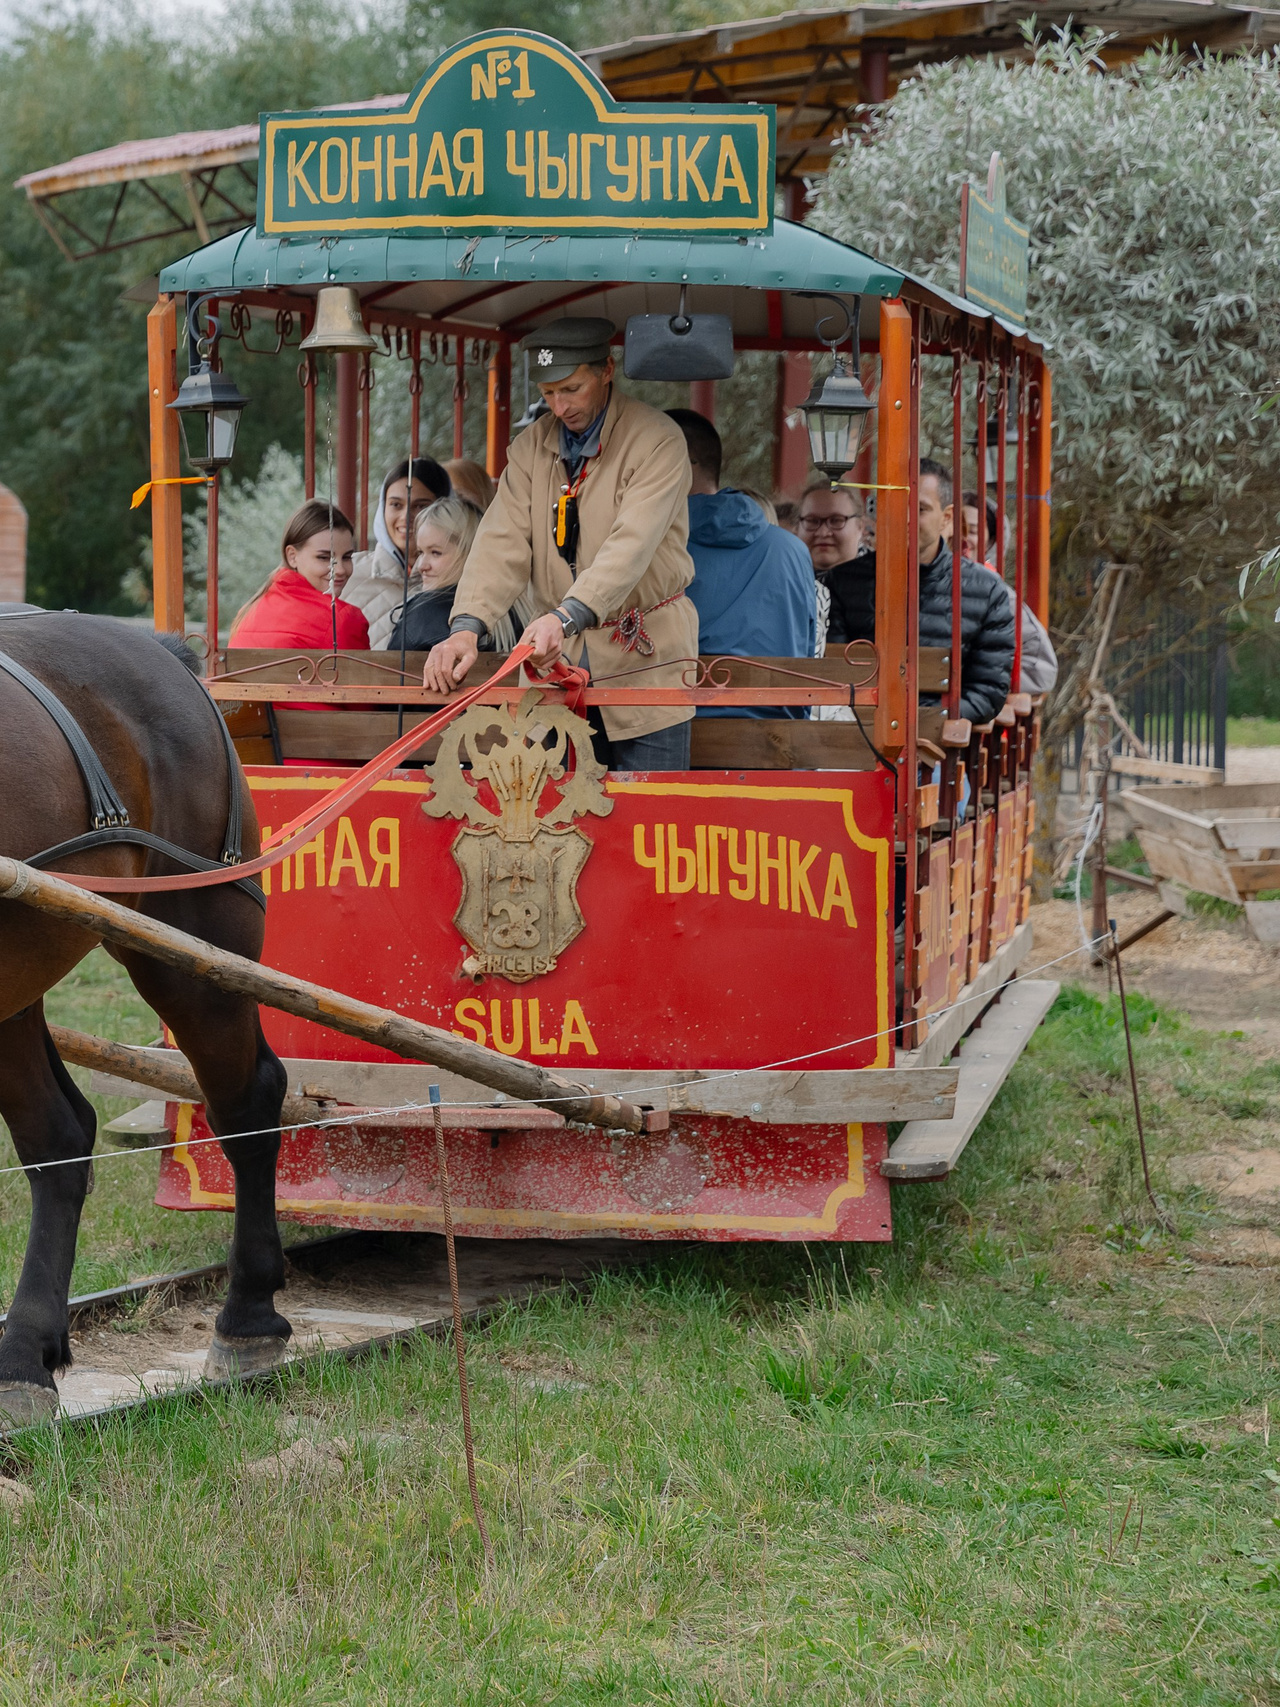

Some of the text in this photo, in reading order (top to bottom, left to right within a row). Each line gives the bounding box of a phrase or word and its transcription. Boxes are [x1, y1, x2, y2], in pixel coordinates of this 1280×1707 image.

[287, 128, 752, 207] КОННАЯ ЧЫГУНКА
[261, 816, 400, 896] ННАЯ
[633, 823, 858, 928] ЧЫГУНКА
[451, 997, 599, 1056] SULA
